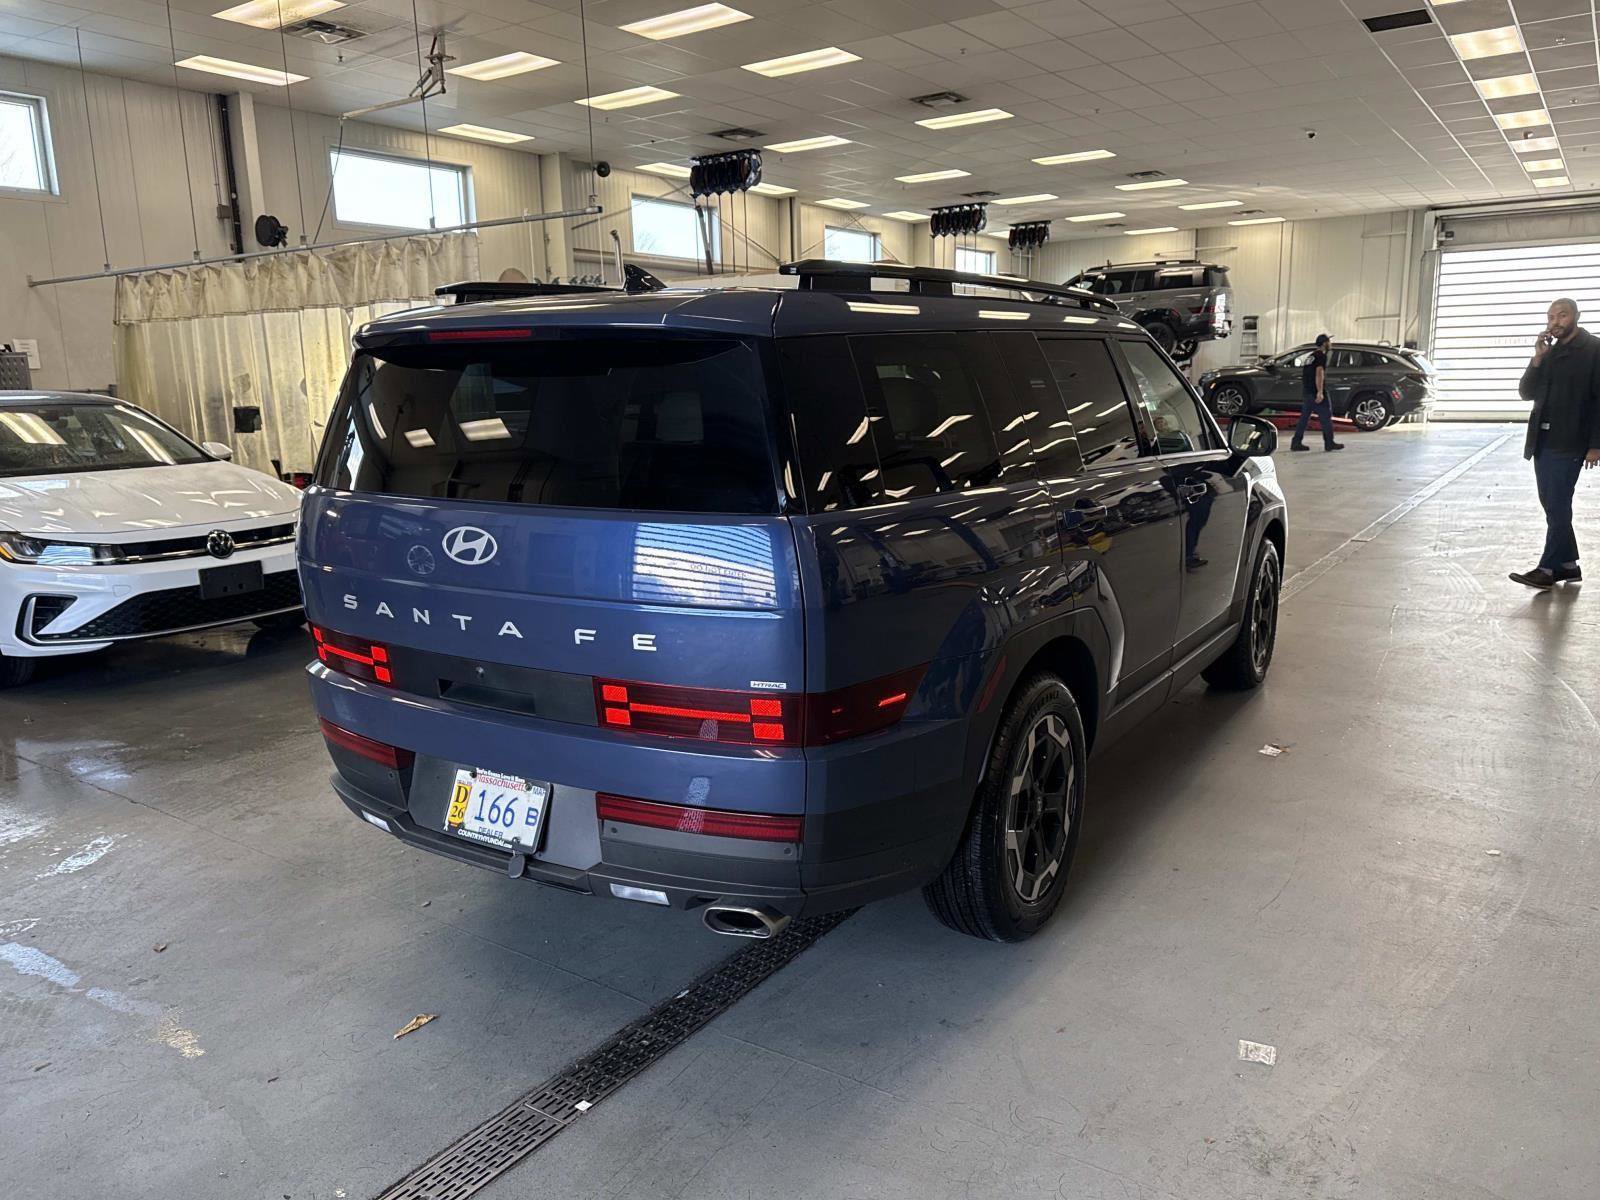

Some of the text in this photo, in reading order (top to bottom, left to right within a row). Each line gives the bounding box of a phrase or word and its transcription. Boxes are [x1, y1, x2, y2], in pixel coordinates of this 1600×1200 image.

[343, 593, 657, 652] SANTA FE
[752, 681, 785, 689] HTRAC
[455, 785, 469, 804] D
[451, 805, 465, 819] 26
[474, 789, 539, 828] 166 B
[479, 827, 504, 839] DEALER
